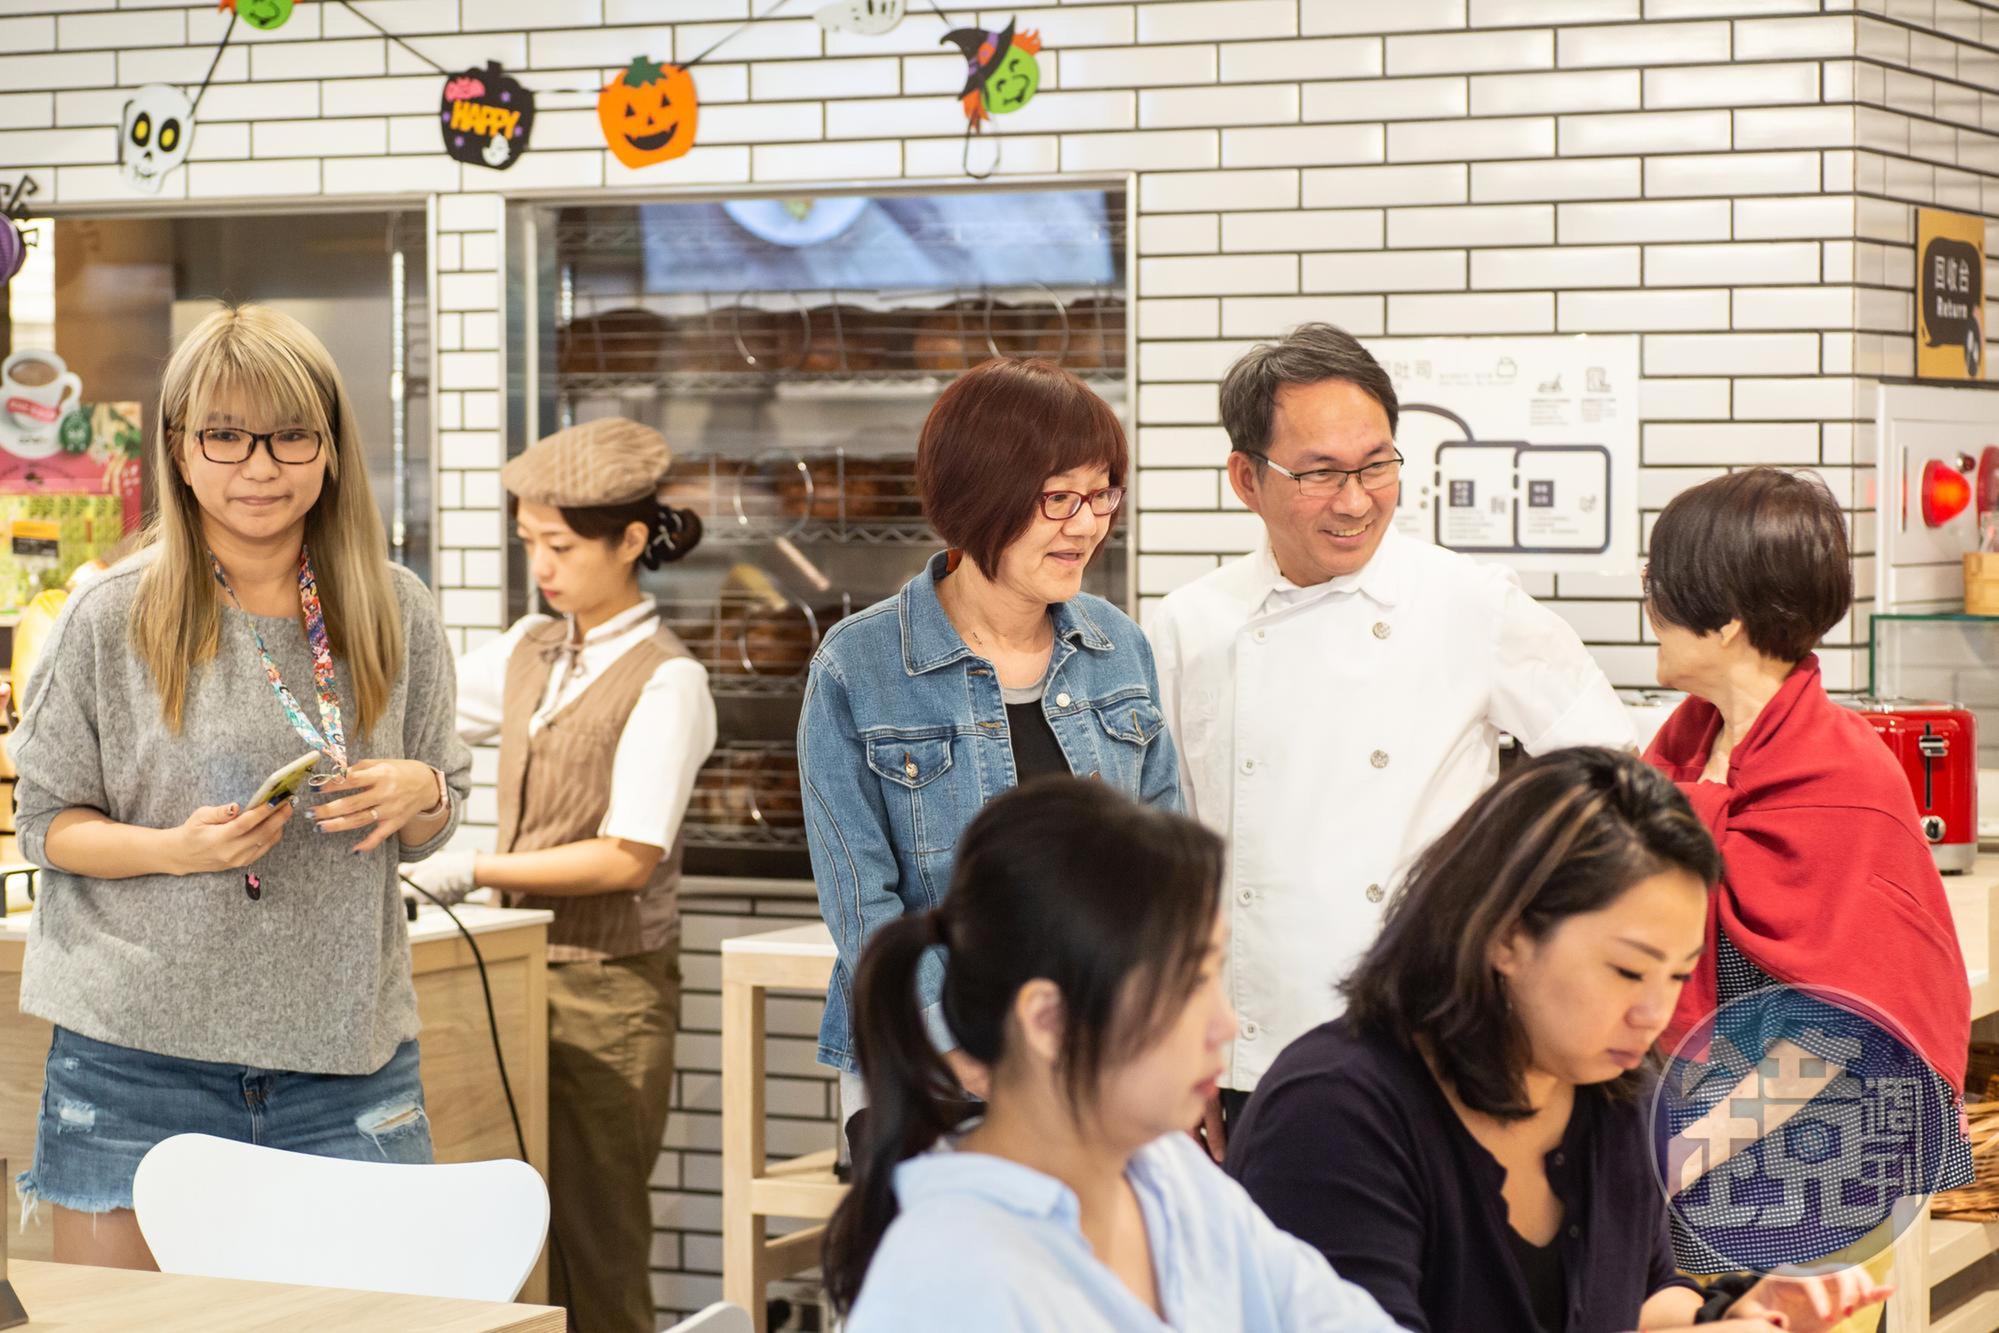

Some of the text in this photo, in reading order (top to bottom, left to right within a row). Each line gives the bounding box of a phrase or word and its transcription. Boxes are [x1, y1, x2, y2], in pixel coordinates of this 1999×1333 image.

[450, 99, 521, 140] HAPPY
[1935, 256, 1969, 292] 回收台
[1937, 296, 1968, 318] Return
